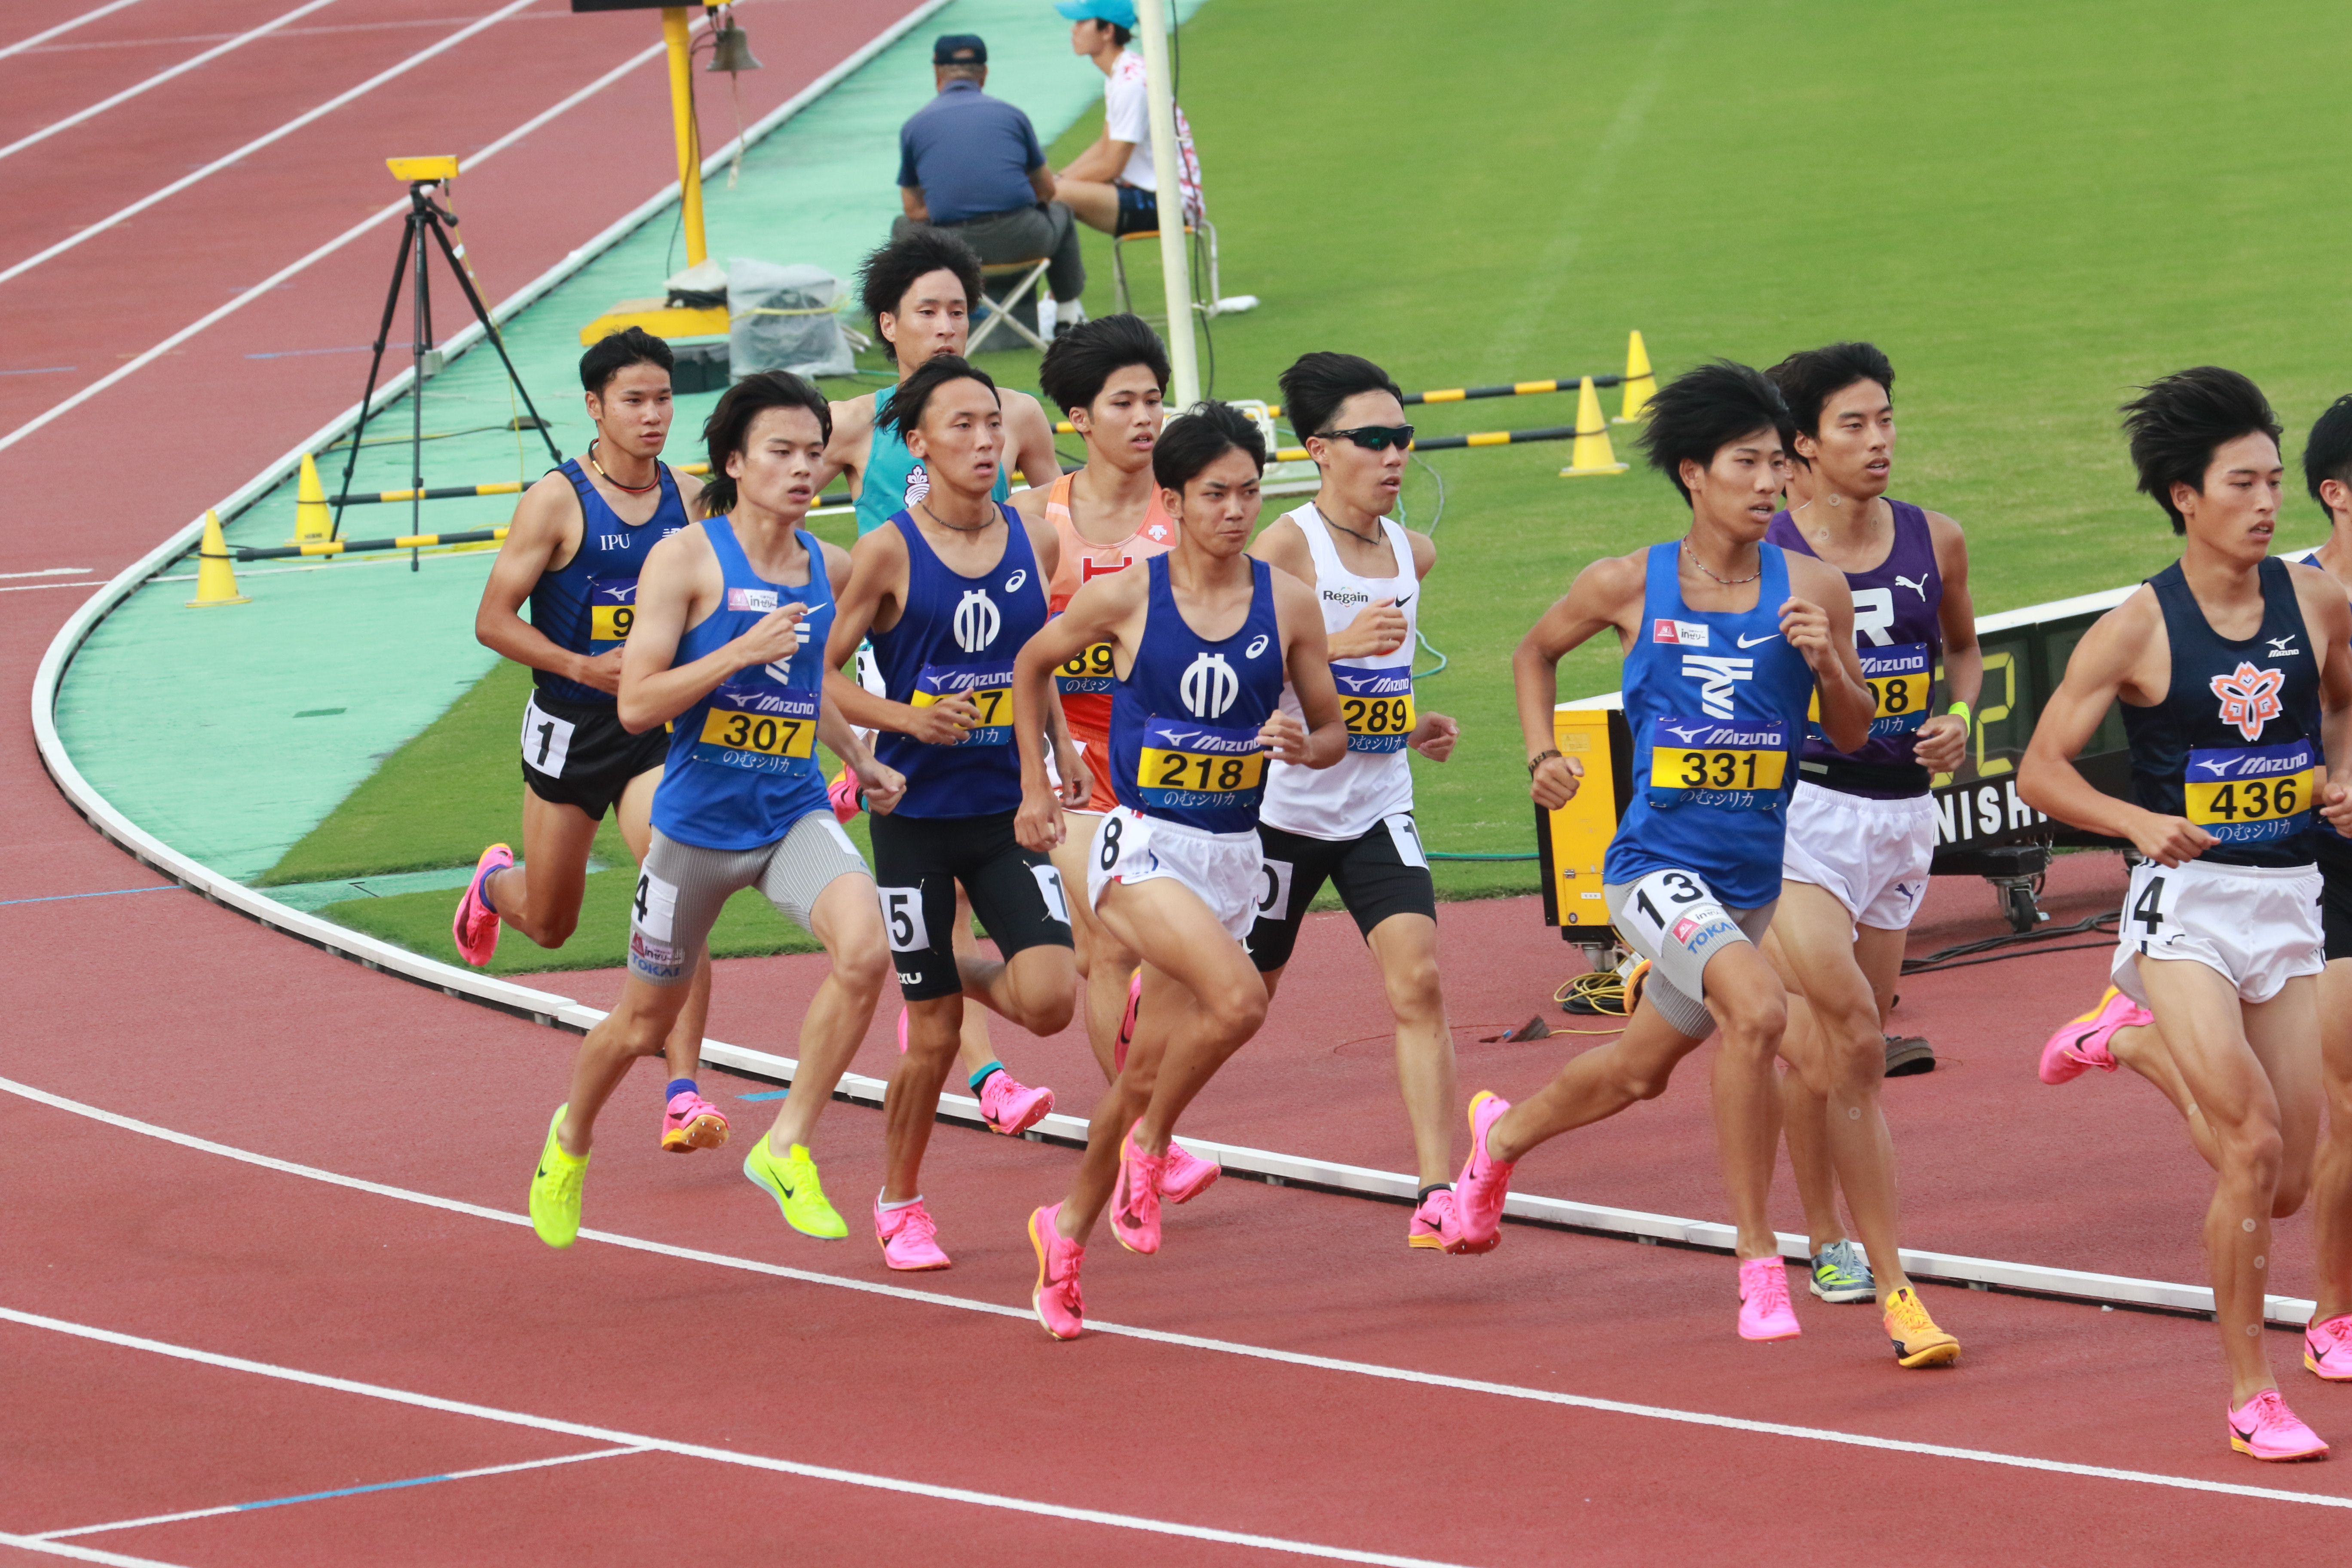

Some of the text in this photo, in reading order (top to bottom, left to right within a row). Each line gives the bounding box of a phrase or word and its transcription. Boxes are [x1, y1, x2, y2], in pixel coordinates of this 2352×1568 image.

[600, 533, 630, 551] IPU
[1323, 590, 1368, 604] Regain
[1850, 588, 1895, 649] R
[1681, 628, 1706, 640] inゼリー
[1369, 677, 1409, 693] MIZUNO
[755, 695, 814, 715] MIZUNO
[1343, 699, 1407, 732] 289
[724, 714, 801, 754] 307
[1704, 729, 1781, 746] MIZUNO
[723, 750, 790, 773] のむシリカ
[1159, 753, 1243, 790] 218
[1681, 752, 1757, 788] 331
[2236, 752, 2307, 775] MIZUNO
[1164, 790, 1236, 807] のむシリカ
[1680, 788, 1754, 808] のむシリカ
[2210, 778, 2297, 820] 436
[1934, 780, 2048, 847] NISH
[2215, 819, 2291, 841] のむシリカ
[1101, 817, 1123, 871] 8
[634, 874, 649, 924] 4
[1637, 873, 1704, 931] 13
[1687, 922, 1738, 955] TOKAI
[632, 952, 680, 977] TOKAI
